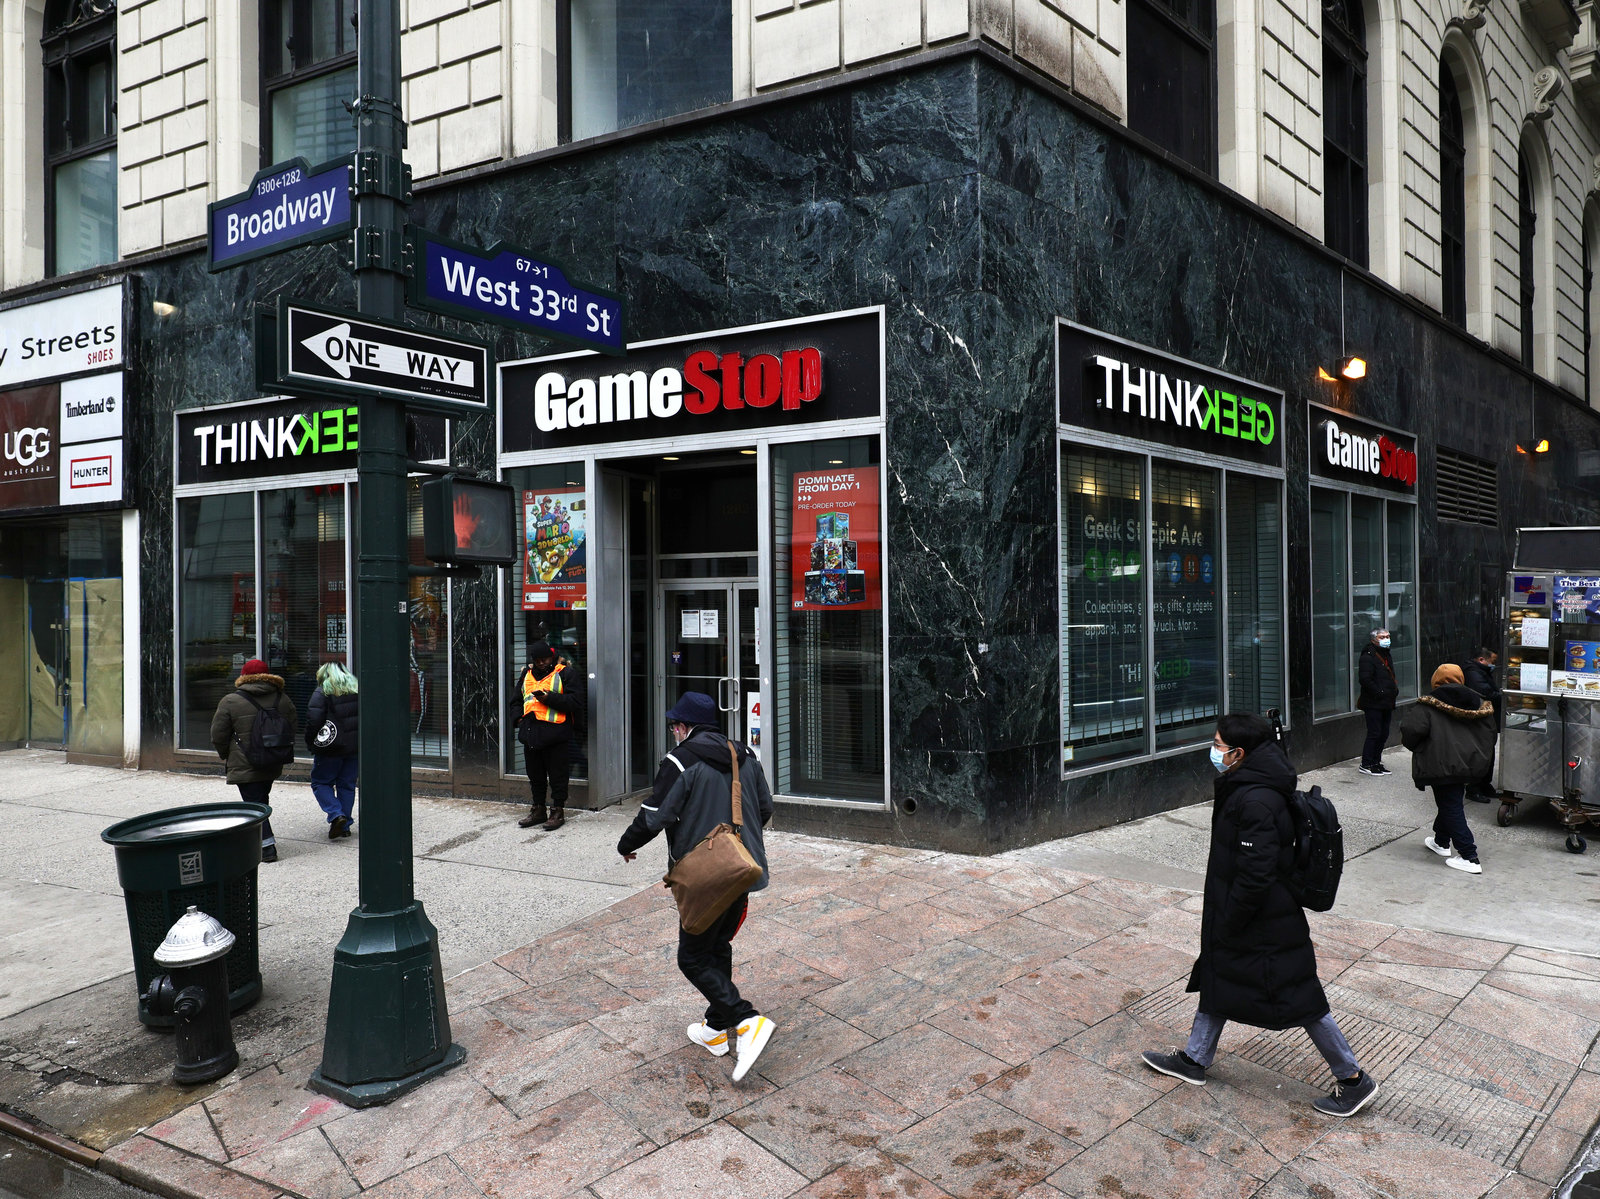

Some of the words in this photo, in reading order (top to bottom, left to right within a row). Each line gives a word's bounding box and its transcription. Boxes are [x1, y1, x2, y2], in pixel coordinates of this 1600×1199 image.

[257, 177, 276, 196] 1300
[281, 168, 301, 188] 1282
[227, 187, 336, 246] Broadway
[516, 257, 532, 273] 67
[440, 256, 520, 311] West
[529, 284, 577, 322] 33rd
[586, 303, 611, 337] St
[21, 325, 116, 360] Streets
[87, 348, 114, 365] SHOES
[325, 336, 380, 368] ONE
[406, 351, 460, 382] WAY
[534, 346, 822, 432] GameStop
[66, 398, 105, 418] Timberland
[4, 427, 50, 467] UGG
[1326, 419, 1417, 487] GameStop
[4, 464, 51, 476] australia
[73, 466, 108, 479] HUNTER
[798, 473, 855, 485] DOMINATE
[798, 485, 829, 493] FROM
[831, 482, 853, 491] DAY
[798, 502, 834, 510] PRE-ORDER
[536, 519, 553, 528] SUPER
[537, 522, 570, 541] MARIO
[1084, 514, 1123, 542] Geek
